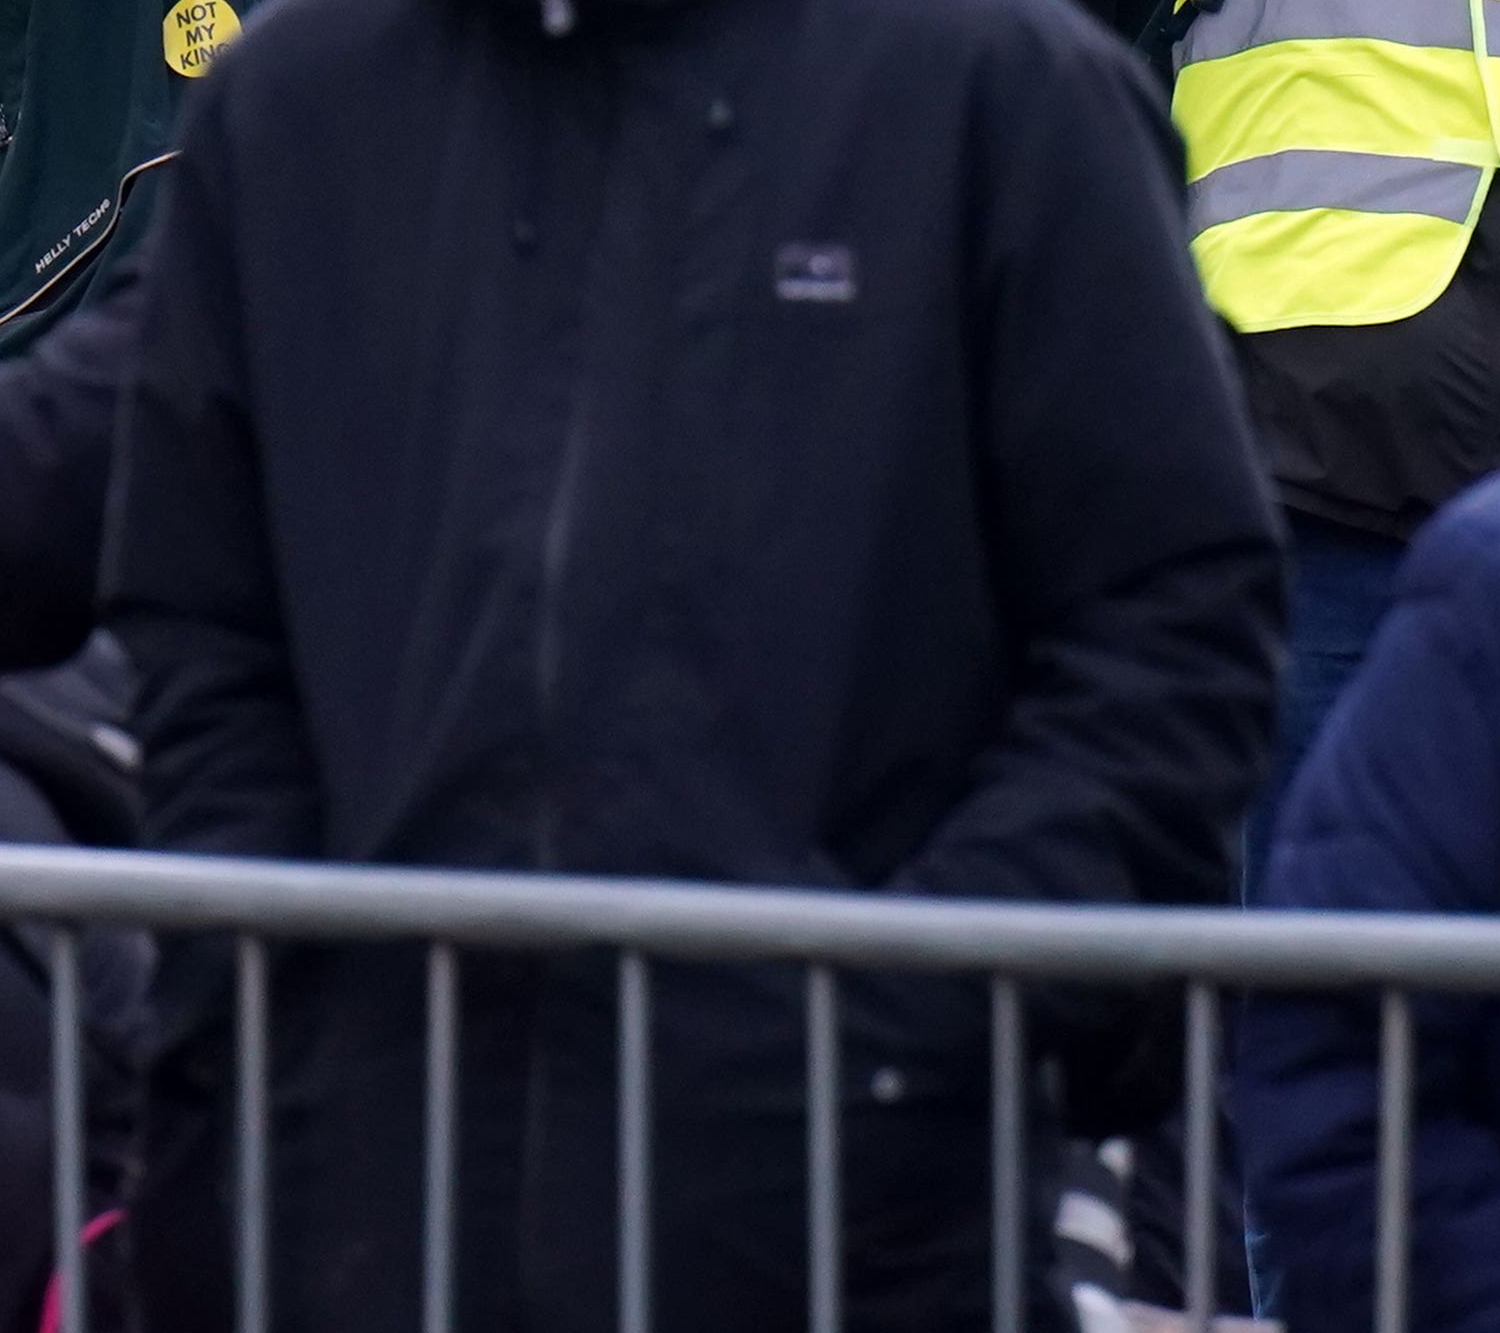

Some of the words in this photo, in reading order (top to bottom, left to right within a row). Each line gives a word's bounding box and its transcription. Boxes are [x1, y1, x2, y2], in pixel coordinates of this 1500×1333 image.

[176, 1, 217, 29] NOT
[185, 22, 216, 48] MY
[35, 233, 71, 274] HELLY
